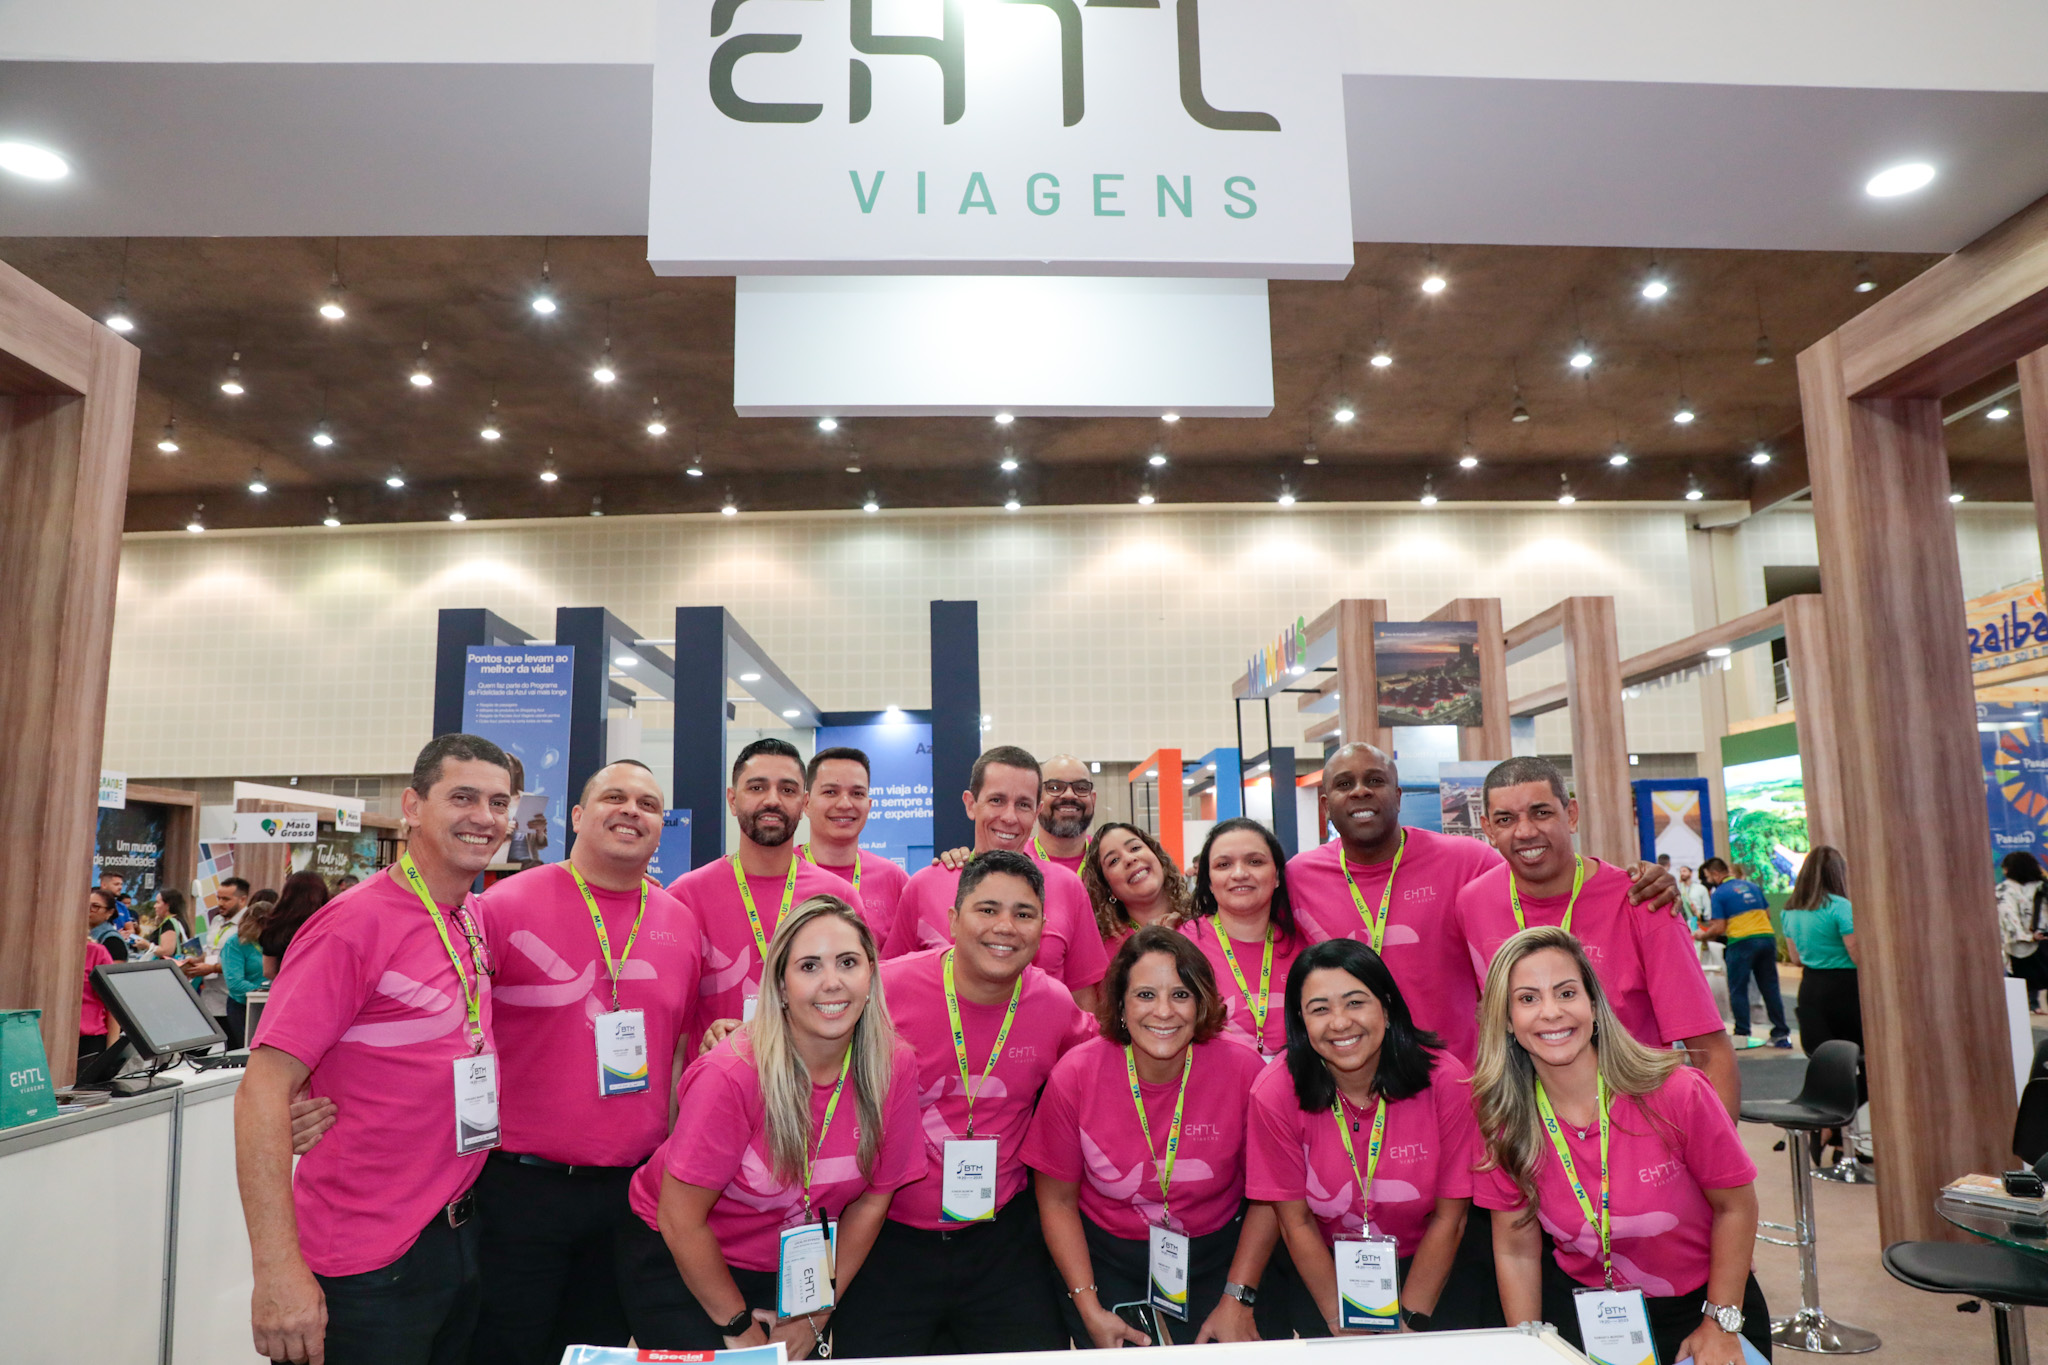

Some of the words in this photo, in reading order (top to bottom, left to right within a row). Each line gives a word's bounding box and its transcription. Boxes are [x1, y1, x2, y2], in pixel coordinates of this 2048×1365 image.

[848, 170, 1258, 219] VIAGENS
[468, 654, 502, 663] Pontos
[504, 655, 522, 665] que
[524, 654, 553, 663] levam
[555, 655, 568, 663] ao
[1248, 616, 1306, 697] MANAUS
[481, 664, 514, 673] melhor
[517, 664, 529, 673] da
[531, 664, 554, 673] vida!
[506, 682, 520, 690] parte
[530, 682, 557, 690] Programa
[886, 784, 911, 796] viaja
[914, 784, 928, 794] de
[881, 797, 922, 808] sempre
[925, 798, 932, 806] a
[285, 821, 311, 829] Mato
[116, 840, 130, 852] Um
[131, 842, 157, 852] mundo
[105, 854, 156, 867] possibilidades
[582, 887, 592, 900] BTM
[1404, 886, 1437, 900] EHTL
[1356, 898, 1365, 911] BTM
[1379, 885, 1391, 919] MANAUS
[594, 915, 608, 951] MANAUS
[749, 911, 764, 942] MANAUS
[649, 931, 678, 942] EHTL
[1226, 949, 1241, 977] MANAUS
[1259, 988, 1267, 1017] MANAUS
[955, 1031, 967, 1071] MANAUS
[989, 1029, 1007, 1066] MANAUS
[1008, 1046, 1037, 1058] EHTL
[10, 1068, 45, 1087] EHTL
[475, 1067, 487, 1075] BTM
[1128, 1059, 1141, 1098] MANAUS
[1169, 1112, 1180, 1152] MANAUS
[1185, 1124, 1219, 1136] EHTL
[1371, 1115, 1384, 1156] MANAUS
[1390, 1143, 1428, 1159] EHTL
[1562, 1153, 1585, 1199] MANAUS
[1638, 1160, 1680, 1182] EHTL
[1166, 1242, 1178, 1251] BTM
[1361, 1254, 1381, 1262] BTM
[803, 1267, 815, 1303] EHTL
[1604, 1306, 1627, 1314] BTM
[649, 1353, 703, 1361] Special
